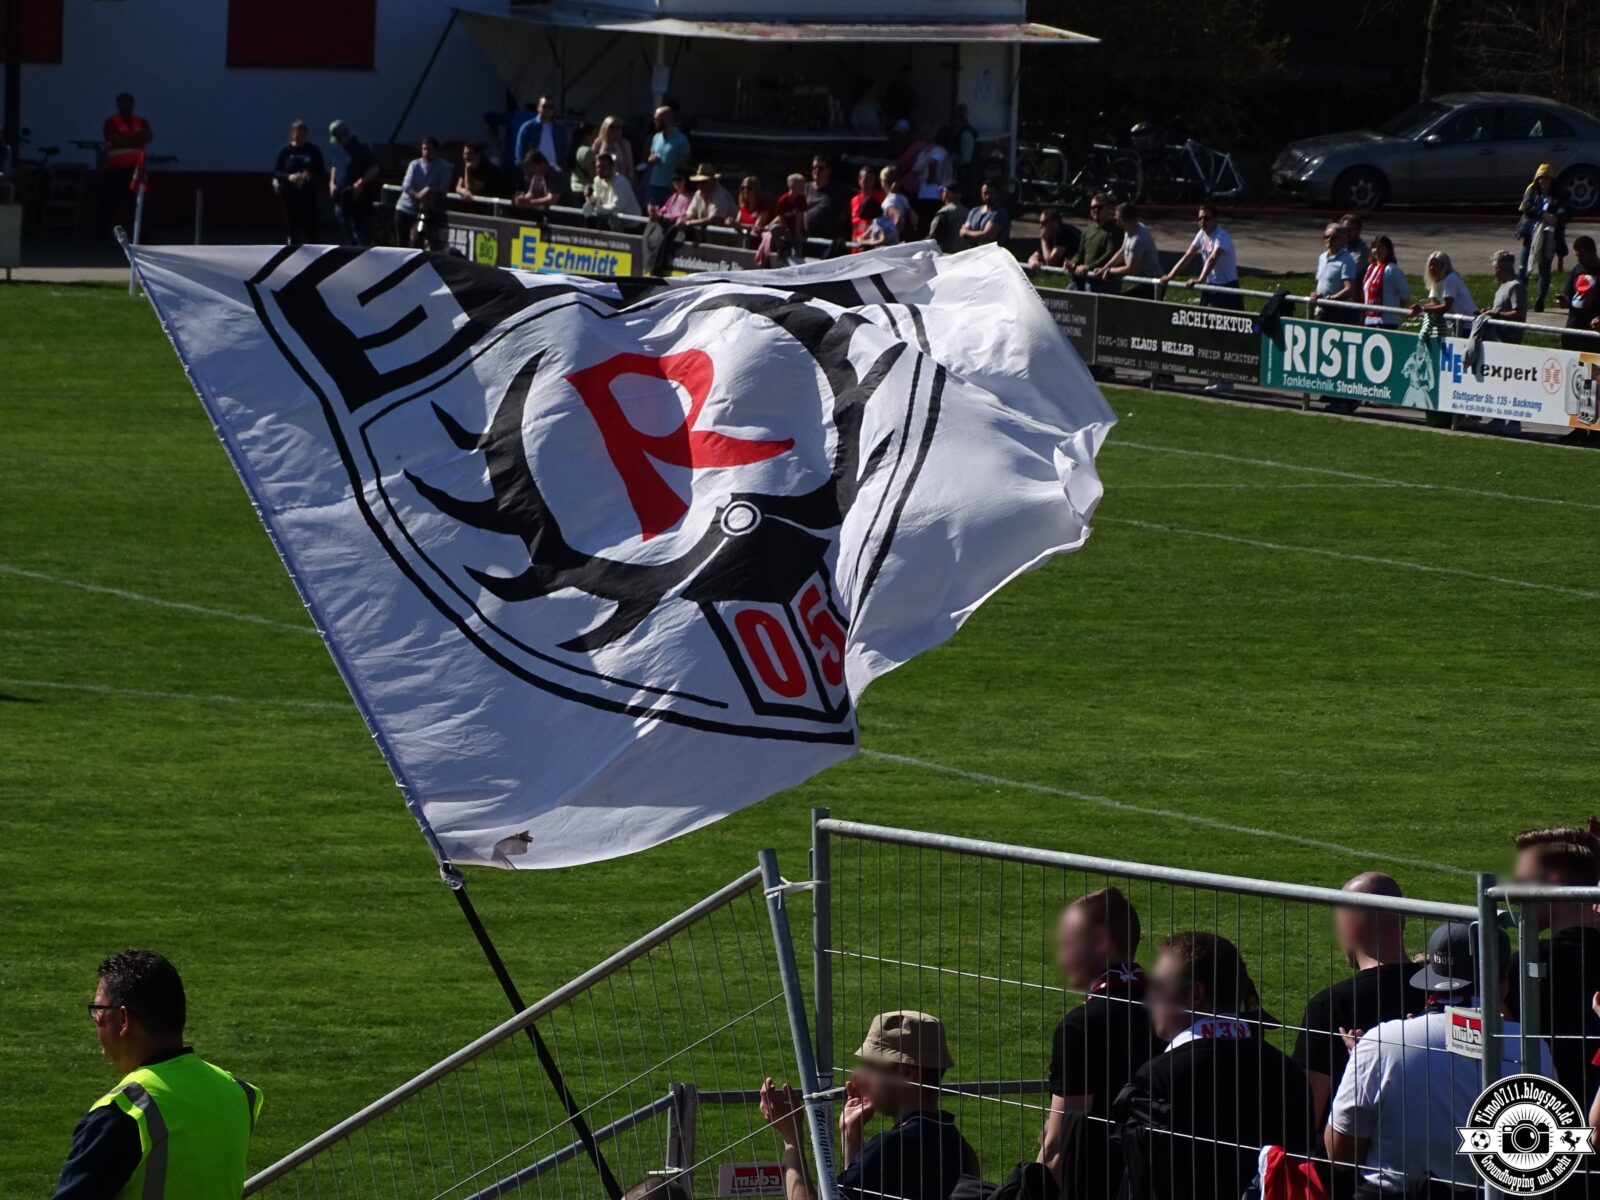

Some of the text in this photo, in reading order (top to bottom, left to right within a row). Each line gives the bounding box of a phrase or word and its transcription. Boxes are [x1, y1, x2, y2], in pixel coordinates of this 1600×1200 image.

[1130, 336, 1158, 352] KLAUS
[1161, 340, 1195, 357] WELLER
[1283, 324, 1393, 384] RISTO
[1481, 363, 1538, 383] expert
[1282, 373, 1392, 399] Tanktechnik Strahltechnik
[1452, 390, 1484, 404] Stuttgarter
[1497, 395, 1508, 407] 135
[1512, 398, 1543, 413] Backnang
[565, 349, 795, 542] R
